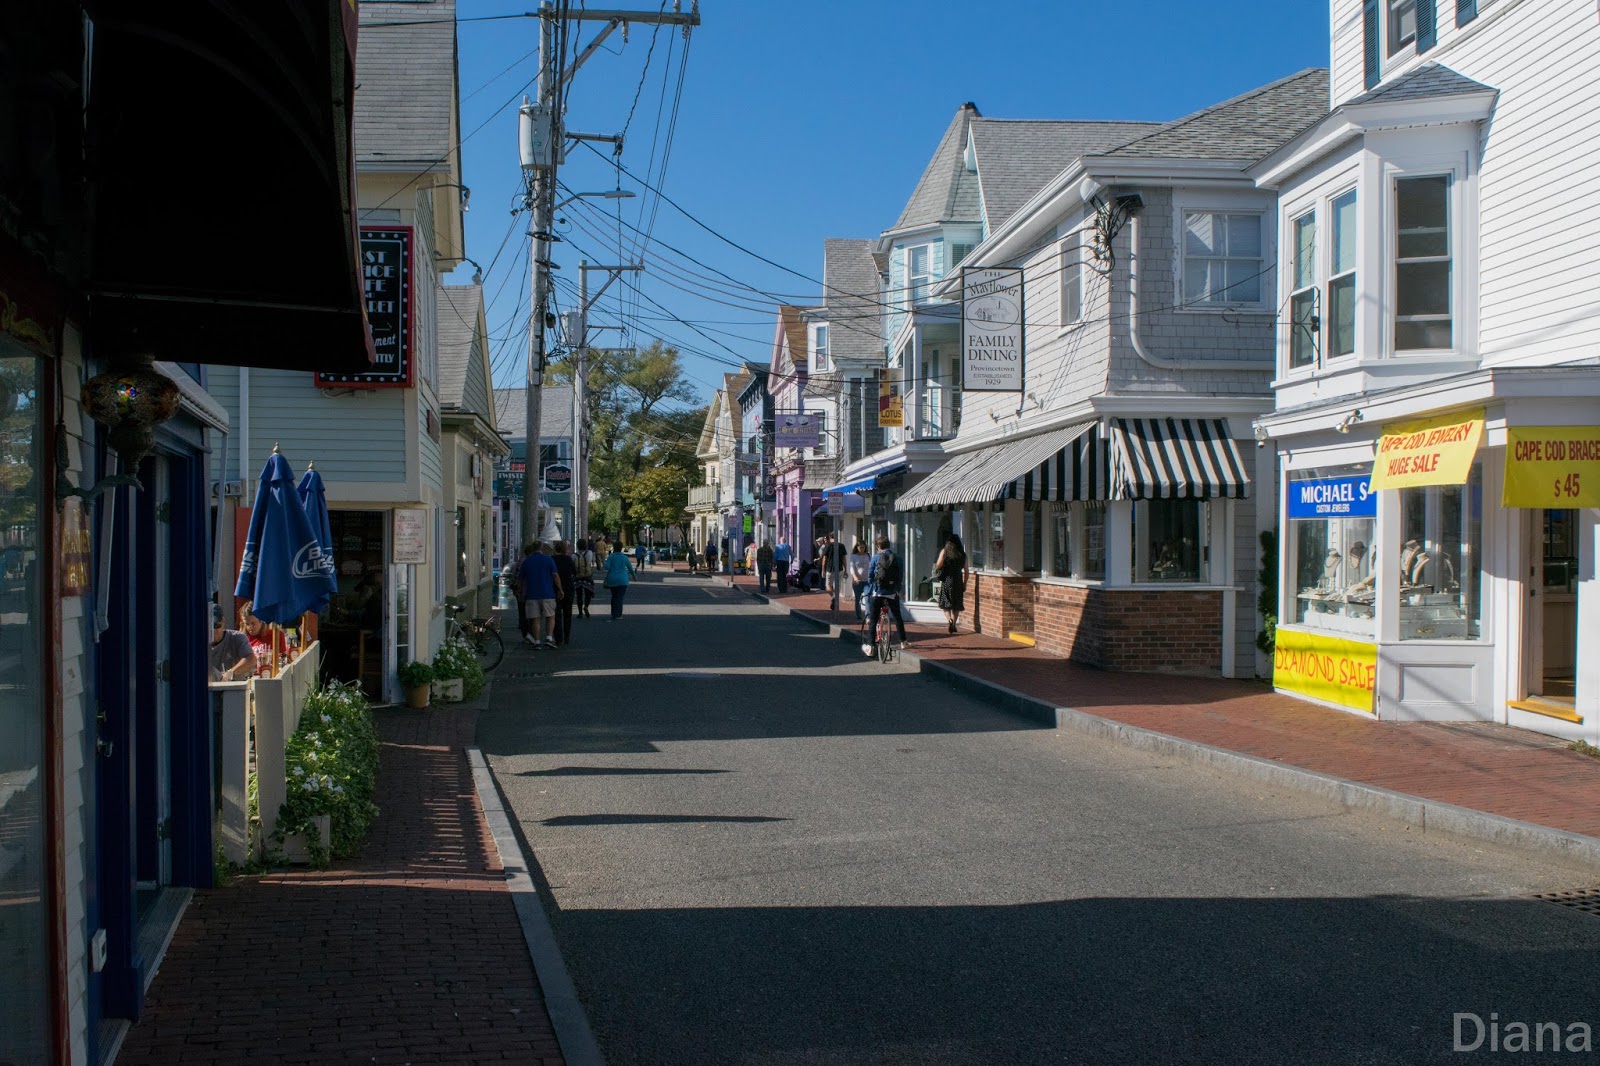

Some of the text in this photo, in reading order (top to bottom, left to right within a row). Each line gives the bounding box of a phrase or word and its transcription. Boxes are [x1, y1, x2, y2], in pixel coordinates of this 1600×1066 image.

[967, 280, 1019, 297] Mayflower
[968, 335, 1017, 347] FAMILY
[968, 349, 1018, 361] DINING
[970, 364, 1015, 372] Provincetown
[881, 409, 902, 418] LOTUS
[1381, 421, 1474, 453] CAPE COD JEWELRY
[1515, 440, 1542, 461] CAPE
[1545, 440, 1566, 461] COD
[1387, 453, 1441, 477] HUGE SALE
[1564, 473, 1580, 498] 45
[1316, 503, 1350, 513] CUSTOM JEWELERS
[1275, 645, 1376, 691] DIAMOND SALE
